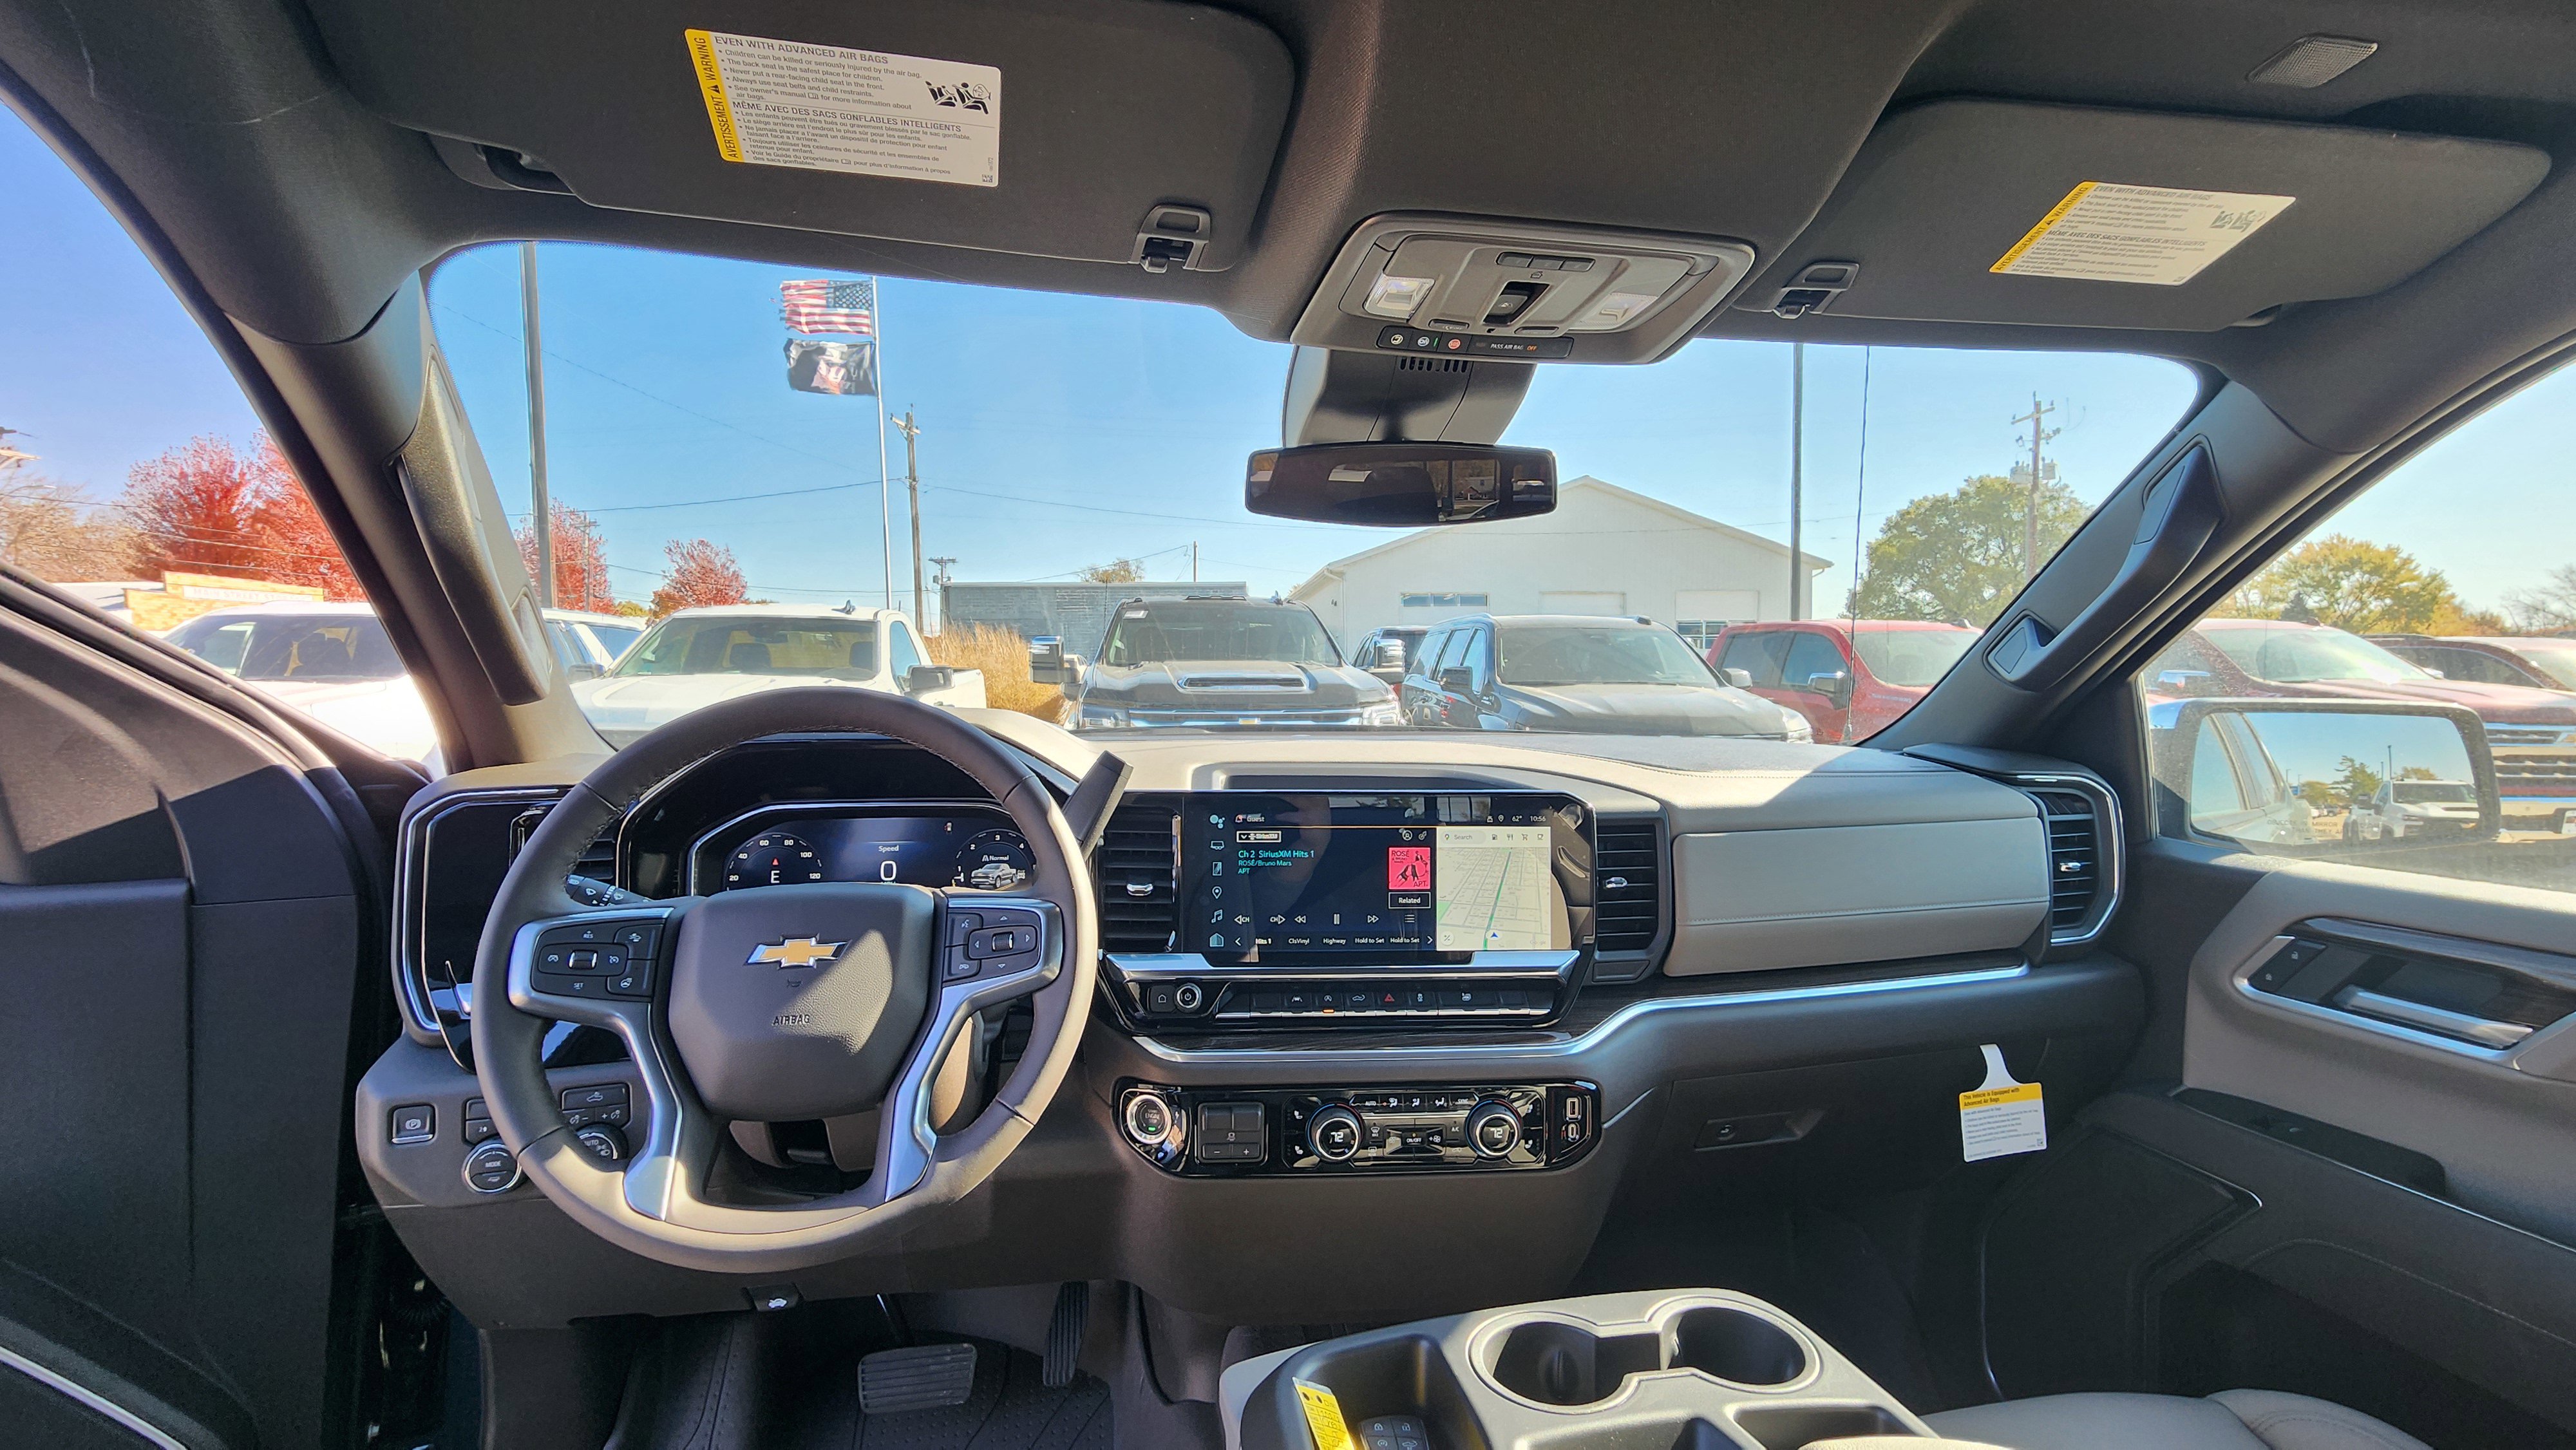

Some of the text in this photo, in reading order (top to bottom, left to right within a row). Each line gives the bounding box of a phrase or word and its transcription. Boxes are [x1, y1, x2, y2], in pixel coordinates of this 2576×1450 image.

[714, 35, 887, 64] EVEN WITH ADVANCED AIR BAGS
[694, 37, 716, 80] WARNING
[724, 49, 755, 58] Children
[782, 55, 803, 64] killed
[814, 61, 845, 70] seriously
[847, 63, 871, 71] injured
[732, 75, 757, 84] Always
[771, 73, 810, 82] rear-facing
[853, 73, 882, 81] children.
[851, 98, 891, 107] information
[732, 100, 961, 132] MÊME AVEC DES SACS GONFLABLES INTELLIGENTS
[712, 97, 738, 158] AVERTISSEMENT
[2052, 187, 2088, 217] WARNING
[2119, 235, 2163, 244] GONFLABLES
[1995, 227, 2045, 270] AVERTISSEMENT
[223, 591, 259, 600] STREET
[1238, 850, 1314, 858] Ch 2 SiriusXM Hits 1
[880, 860, 897, 881] 0
[773, 1014, 810, 1025] AIRBAG
[1331, 1131, 1343, 1142] 72
[1490, 1128, 1503, 1138] 72
